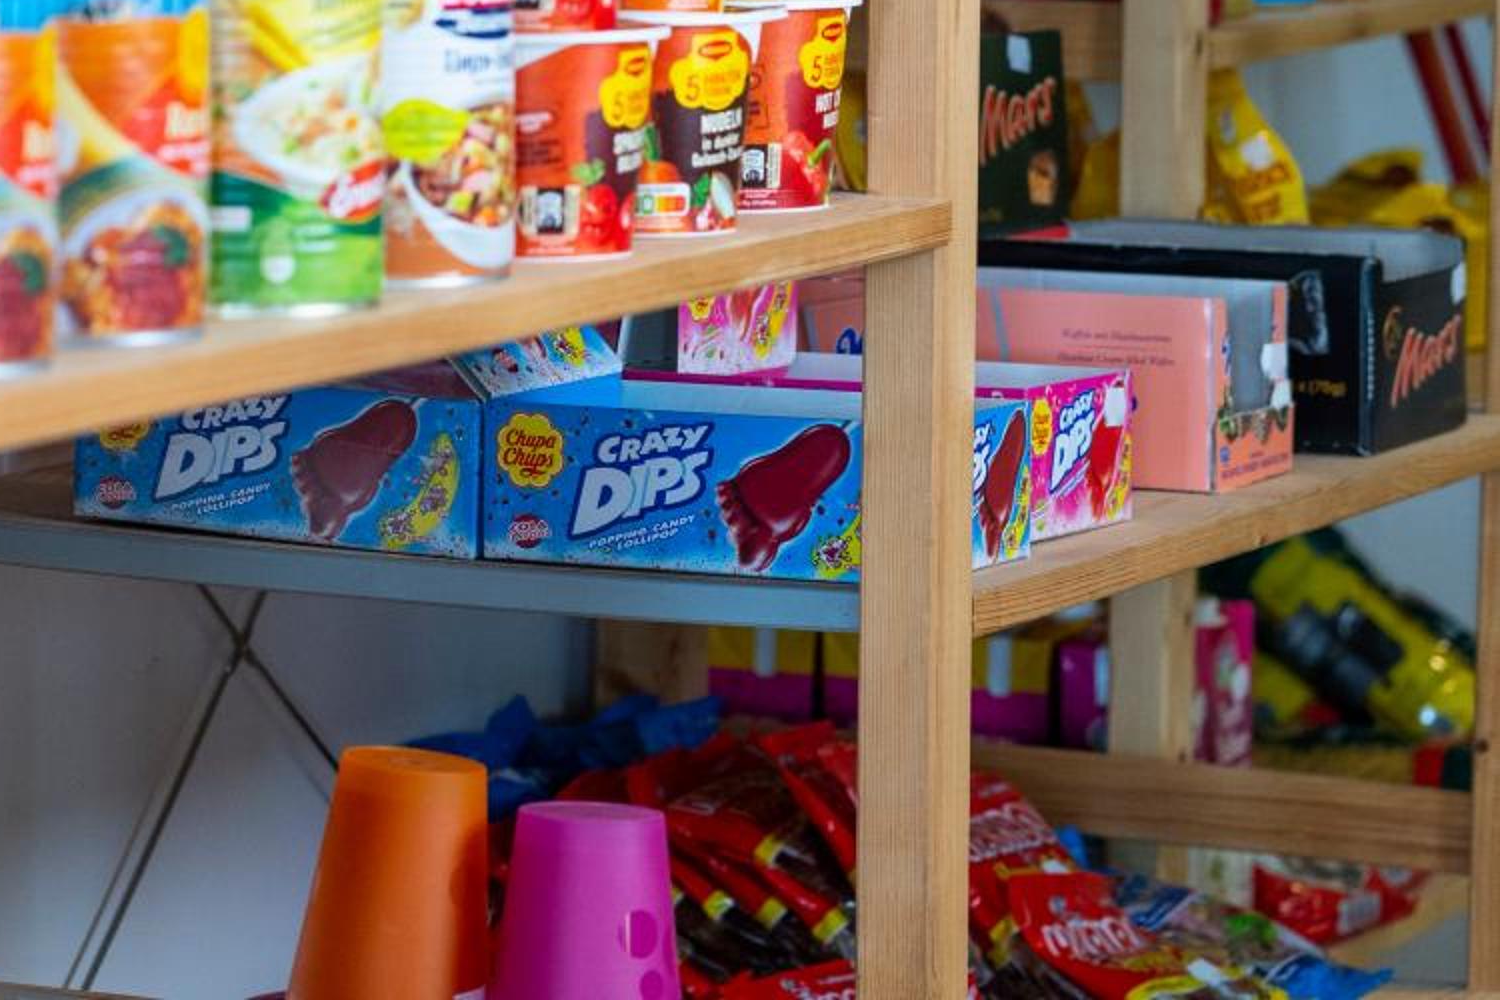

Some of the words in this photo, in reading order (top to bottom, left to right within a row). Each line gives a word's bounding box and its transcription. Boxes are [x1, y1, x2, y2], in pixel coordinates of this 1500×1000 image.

[686, 73, 700, 102] 5
[979, 77, 1056, 168] Mars
[1391, 313, 1461, 408] Mars
[181, 395, 288, 430] CRAZY
[503, 446, 553, 468] Chups
[506, 428, 556, 452] Chupa
[598, 425, 709, 464] CRAZY
[1051, 410, 1095, 491] DIPS
[155, 421, 287, 499] DIPS
[572, 451, 709, 536] DIPS
[616, 527, 679, 551] LOLLIPOP
[653, 514, 695, 532] CANDY
